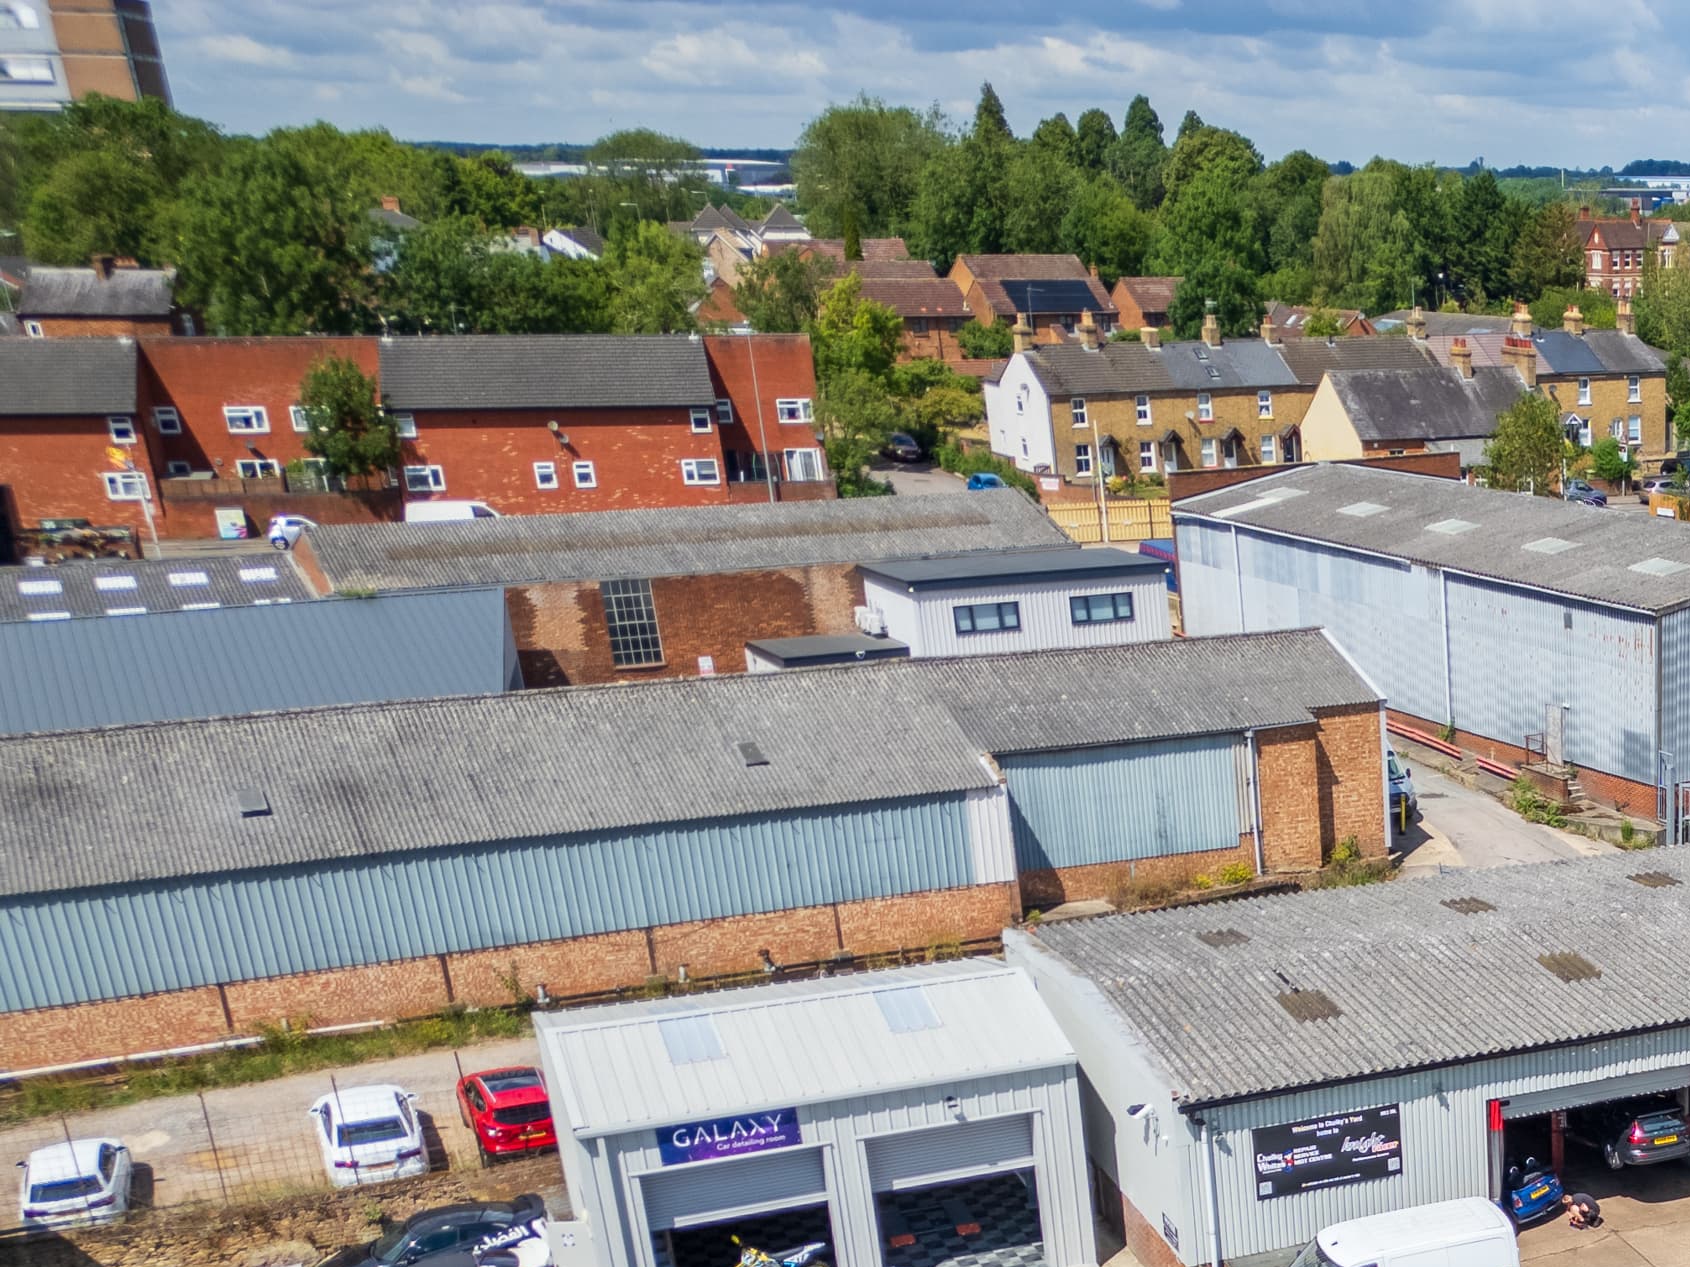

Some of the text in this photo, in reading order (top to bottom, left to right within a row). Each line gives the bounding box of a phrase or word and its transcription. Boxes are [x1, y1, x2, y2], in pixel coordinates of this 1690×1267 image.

[672, 1113, 782, 1148] GALAXY
[1291, 1123, 1318, 1134] Welcome
[1318, 1121, 1325, 1129] to
[1349, 1115, 1363, 1123] Yard
[1316, 1129, 1333, 1137] home
[716, 1135, 786, 1151] Car detailing room
[1293, 1145, 1317, 1153] REPAIR
[1293, 1150, 1320, 1159] SERVICE
